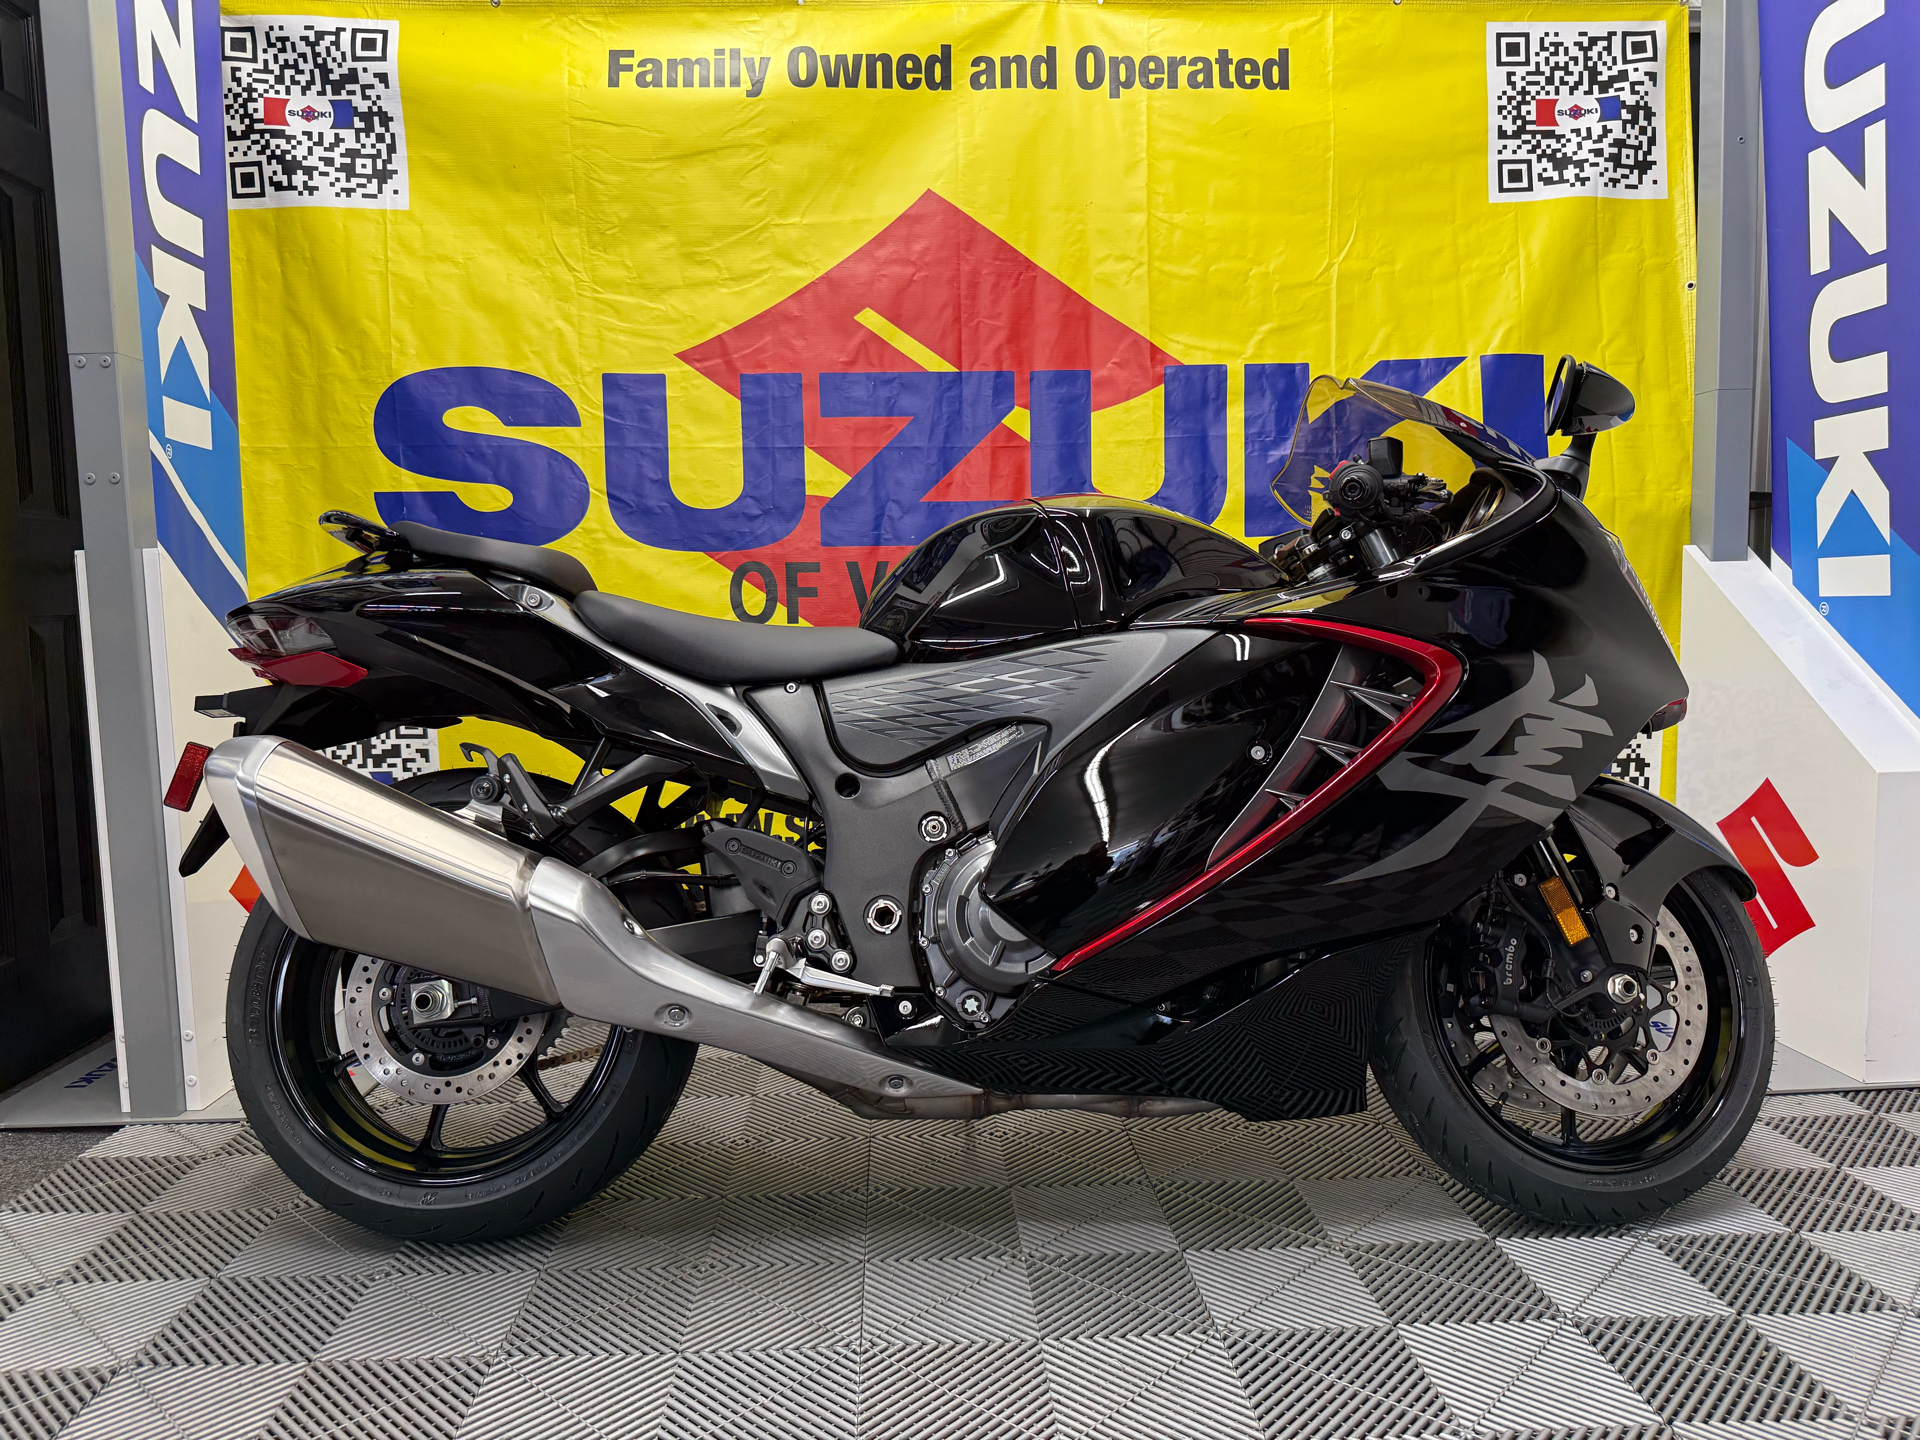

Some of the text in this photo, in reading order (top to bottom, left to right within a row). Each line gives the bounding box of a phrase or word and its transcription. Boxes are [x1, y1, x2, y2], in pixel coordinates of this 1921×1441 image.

[607, 44, 1289, 99] Family Owned and Operated
[287, 109, 332, 119] SUZUKI
[1556, 107, 1599, 117] SUZUKI
[373, 354, 1549, 552] SUZUKI
[729, 560, 821, 625] OF
[741, 847, 782, 869] SUZUKI
[1503, 937, 1518, 986] brembo
